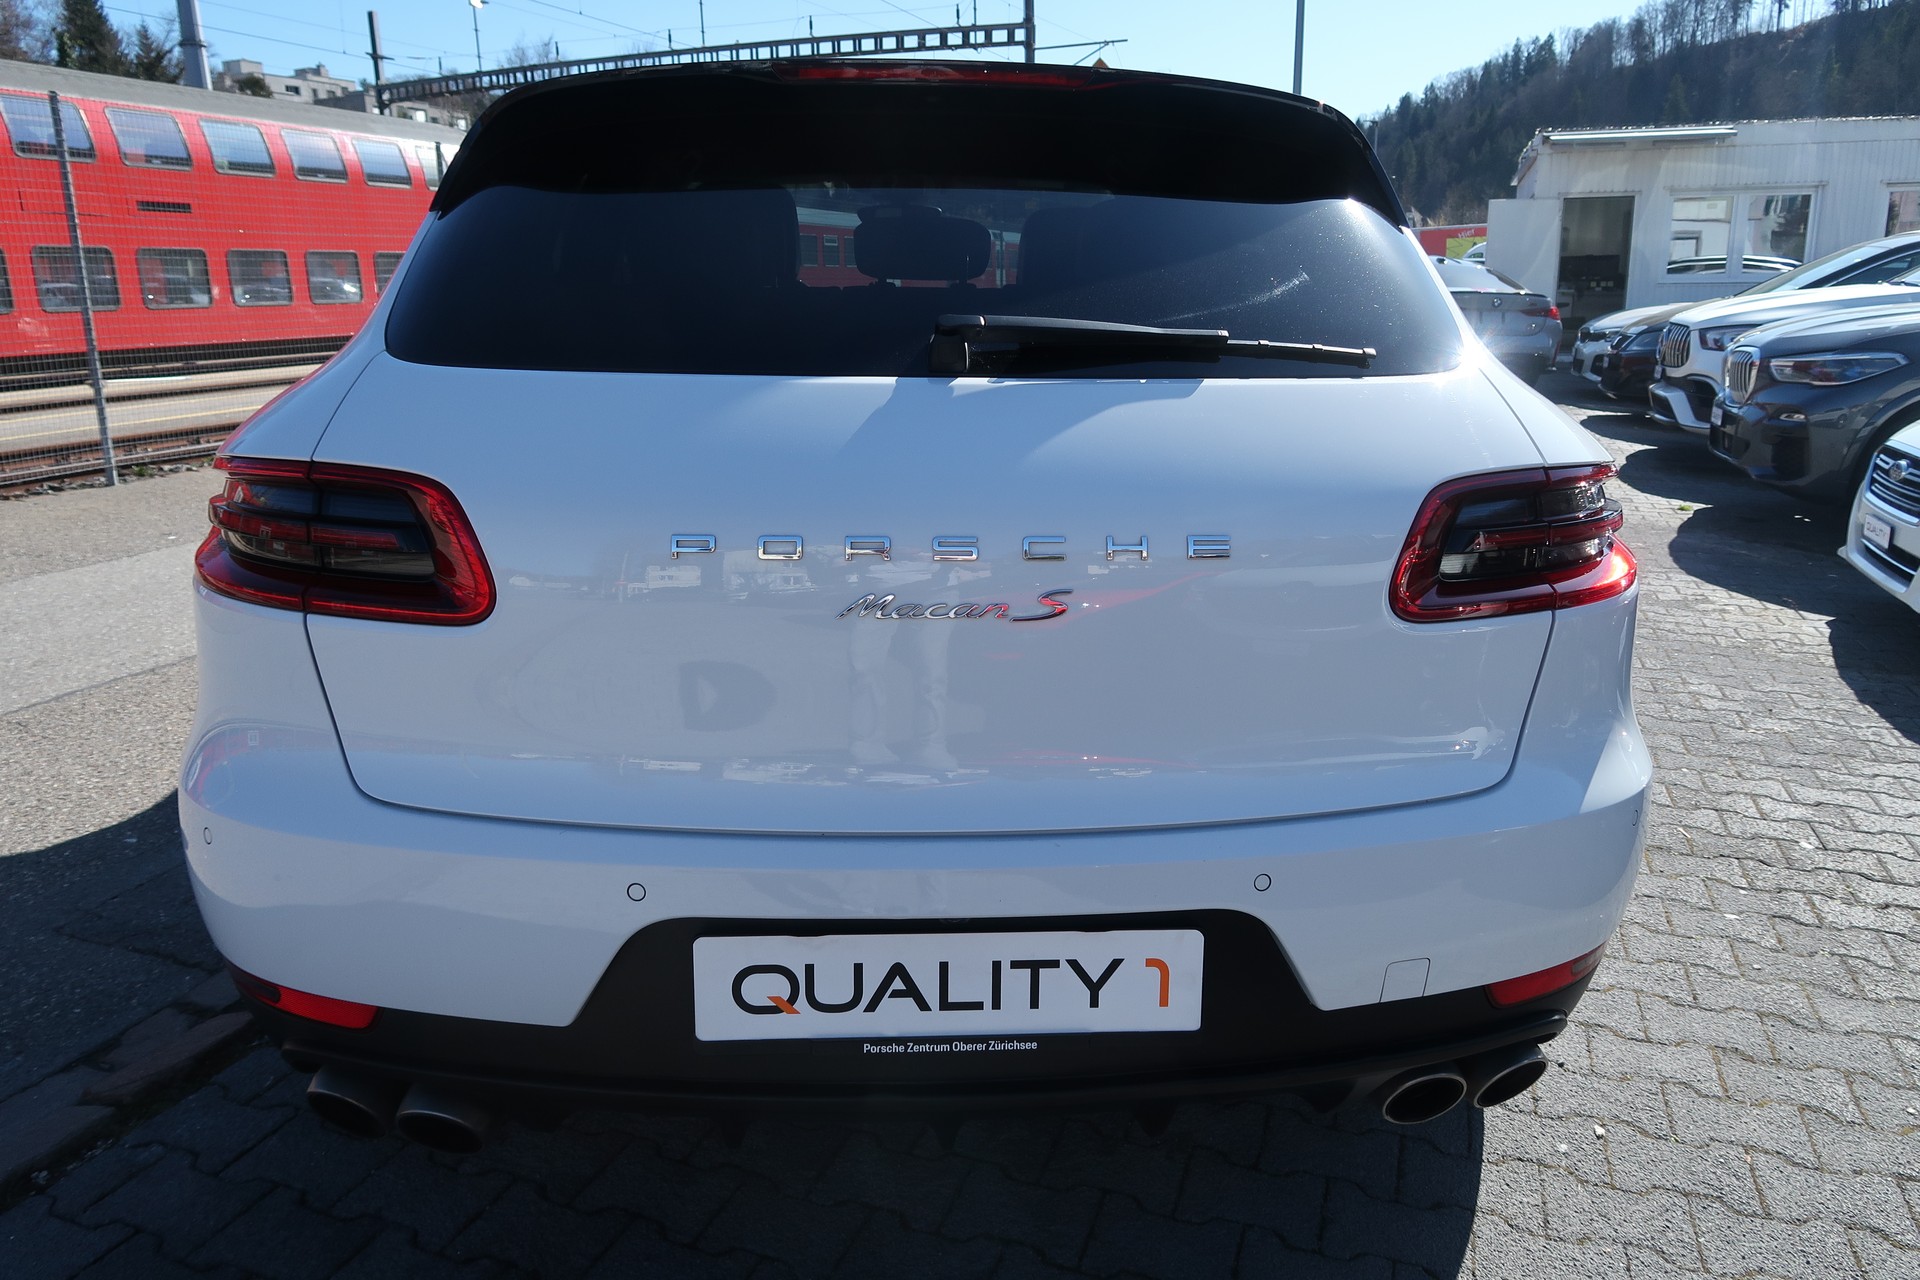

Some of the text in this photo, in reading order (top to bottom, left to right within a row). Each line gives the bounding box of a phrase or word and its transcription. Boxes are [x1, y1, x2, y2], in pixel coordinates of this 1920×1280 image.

[671, 534, 1231, 562] PORSCHE
[835, 588, 1073, 622] Macan S
[731, 958, 1170, 1015] QUALITY 1
[863, 1040, 1038, 1053] Porsche Zentrum Oberer Zürichsee
